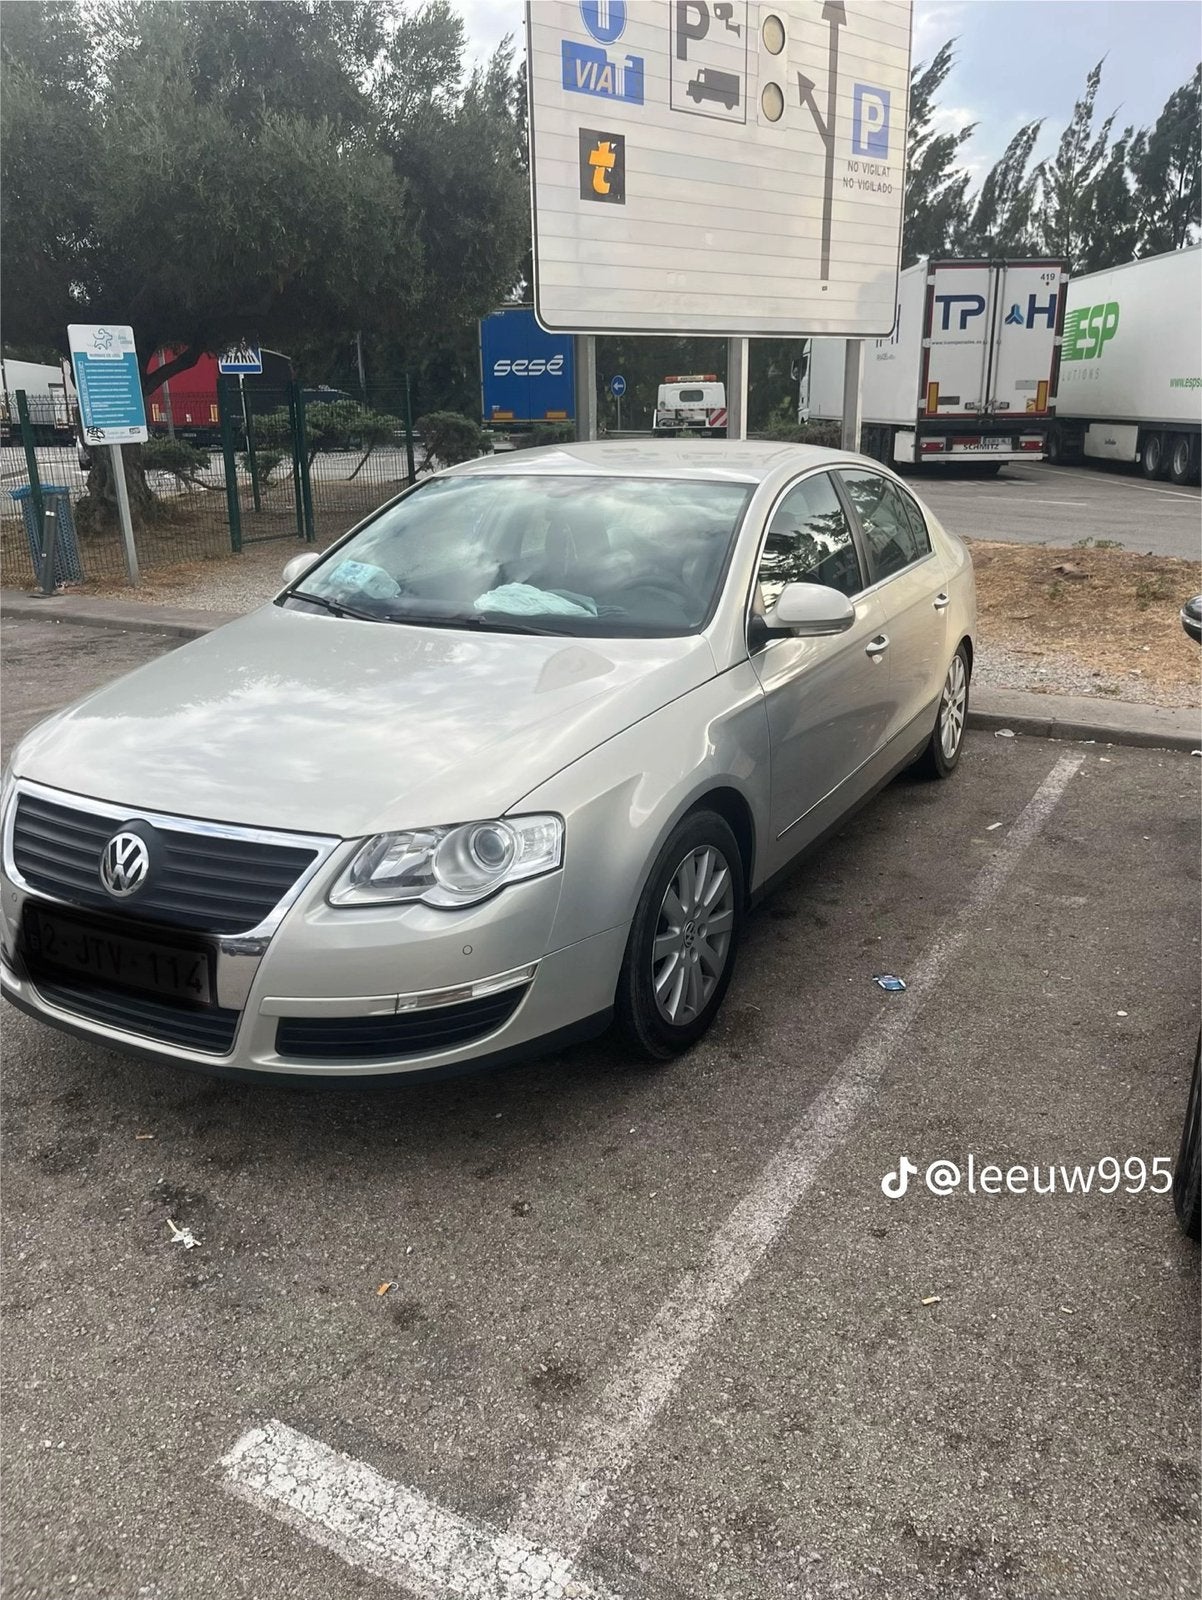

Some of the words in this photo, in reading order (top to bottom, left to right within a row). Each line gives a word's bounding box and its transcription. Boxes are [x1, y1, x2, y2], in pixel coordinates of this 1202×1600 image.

[860, 92, 884, 150] P
[848, 161, 858, 172] NO
[862, 162, 890, 177] VIGILAT
[843, 177, 854, 188] NO
[858, 179, 893, 194] VIGILADO
[1040, 273, 1055, 281] 419
[935, 294, 986, 330] TP
[1062, 301, 1120, 361] ESP
[1062, 367, 1100, 381] LUTIONS
[1170, 378, 1202, 391] www.esps
[963, 443, 999, 451] SCHMITZ
